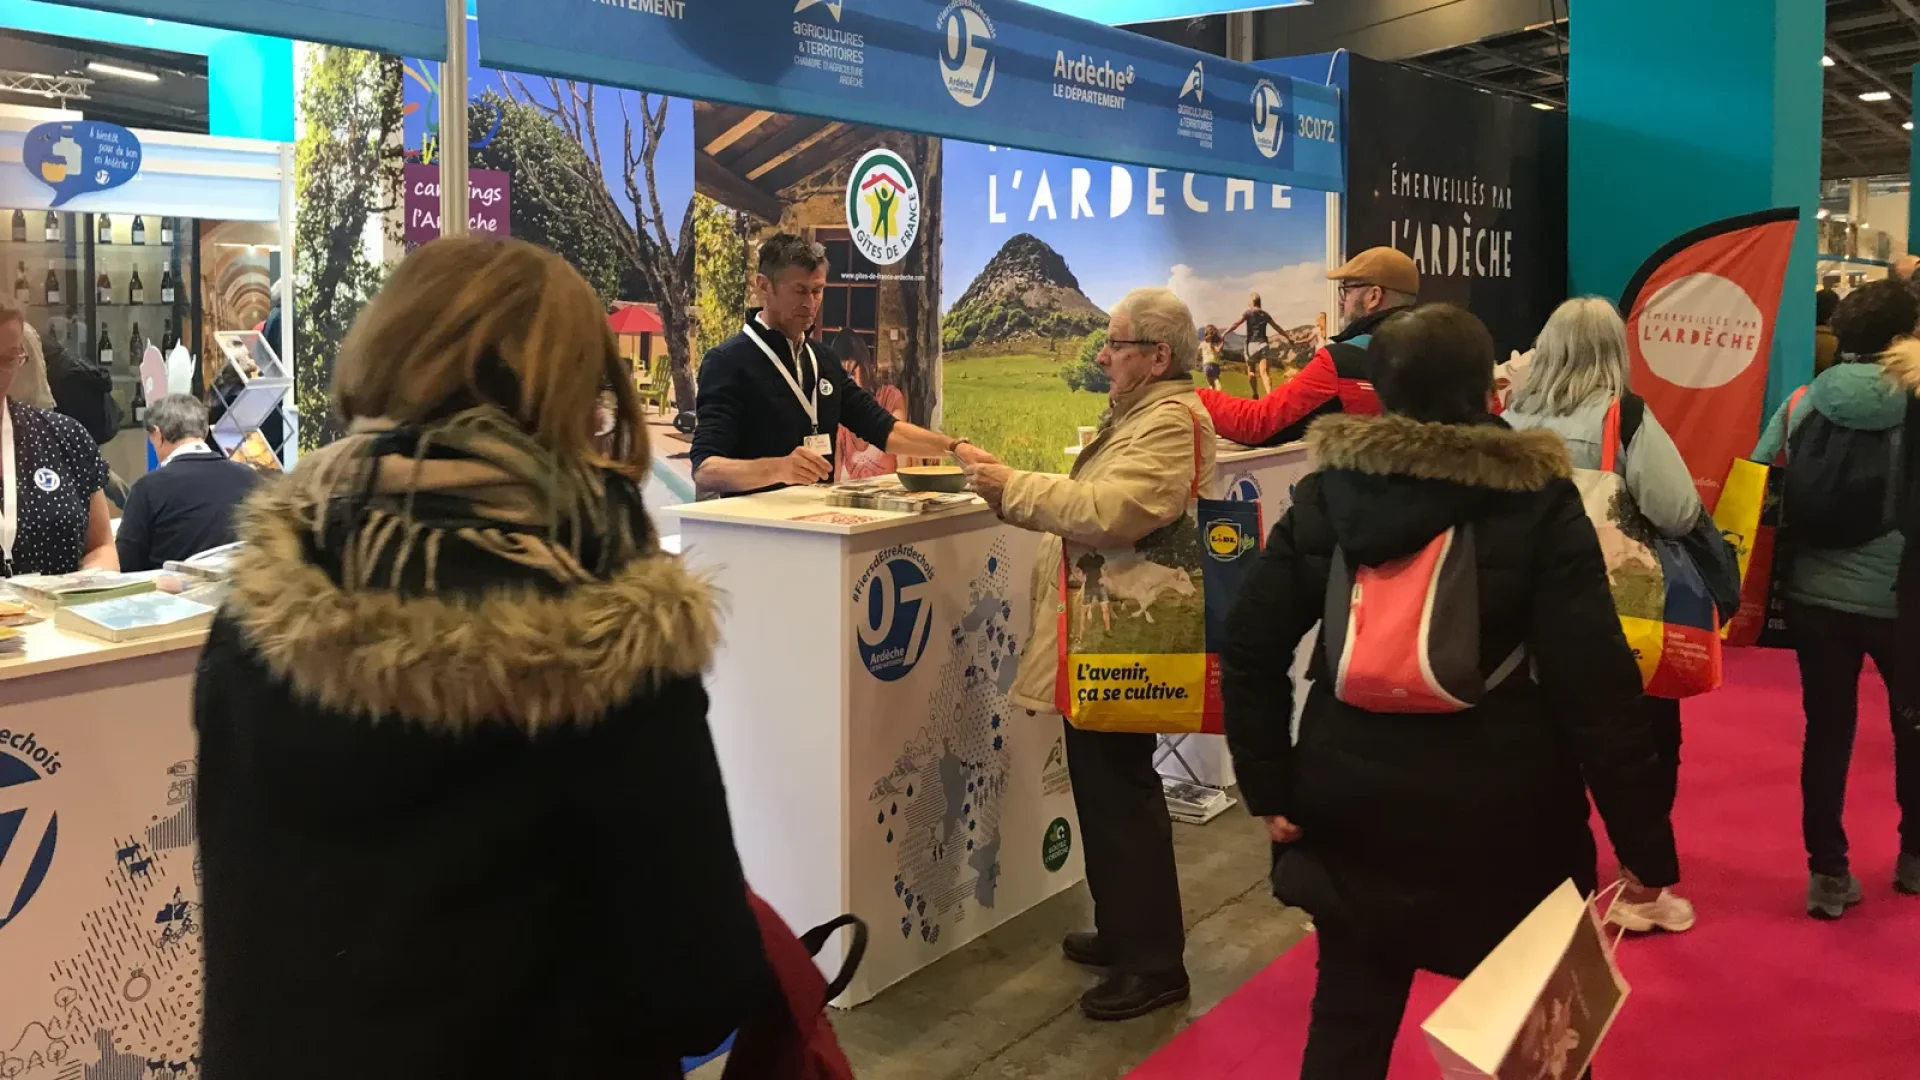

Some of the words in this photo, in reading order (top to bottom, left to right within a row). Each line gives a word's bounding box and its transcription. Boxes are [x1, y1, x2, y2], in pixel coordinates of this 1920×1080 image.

[805, 40, 864, 64] TERRITOIRES
[1053, 49, 1125, 91] Ardèche
[1053, 83, 1064, 98] LE
[1065, 84, 1126, 110] DÉPARTEMENT
[1298, 114, 1335, 143] 3C072
[414, 180, 502, 206] caings
[1392, 161, 1485, 206] ÉMERVEILLÉS
[1492, 185, 1512, 210] PAR
[412, 208, 497, 232] l'Ache
[857, 229, 882, 259] GÎTES
[886, 244, 899, 259] DE
[900, 192, 917, 248] FRANCE
[1643, 325, 1756, 351] L'ARDÈCHE
[852, 543, 936, 603] #FiersdEtreArdechois
[869, 645, 905, 665] Ardèche
[1077, 663, 1149, 683] L'avenir,
[1078, 687, 1099, 706] ça
[1102, 689, 1122, 701] se
[1124, 681, 1189, 700] cultive.
